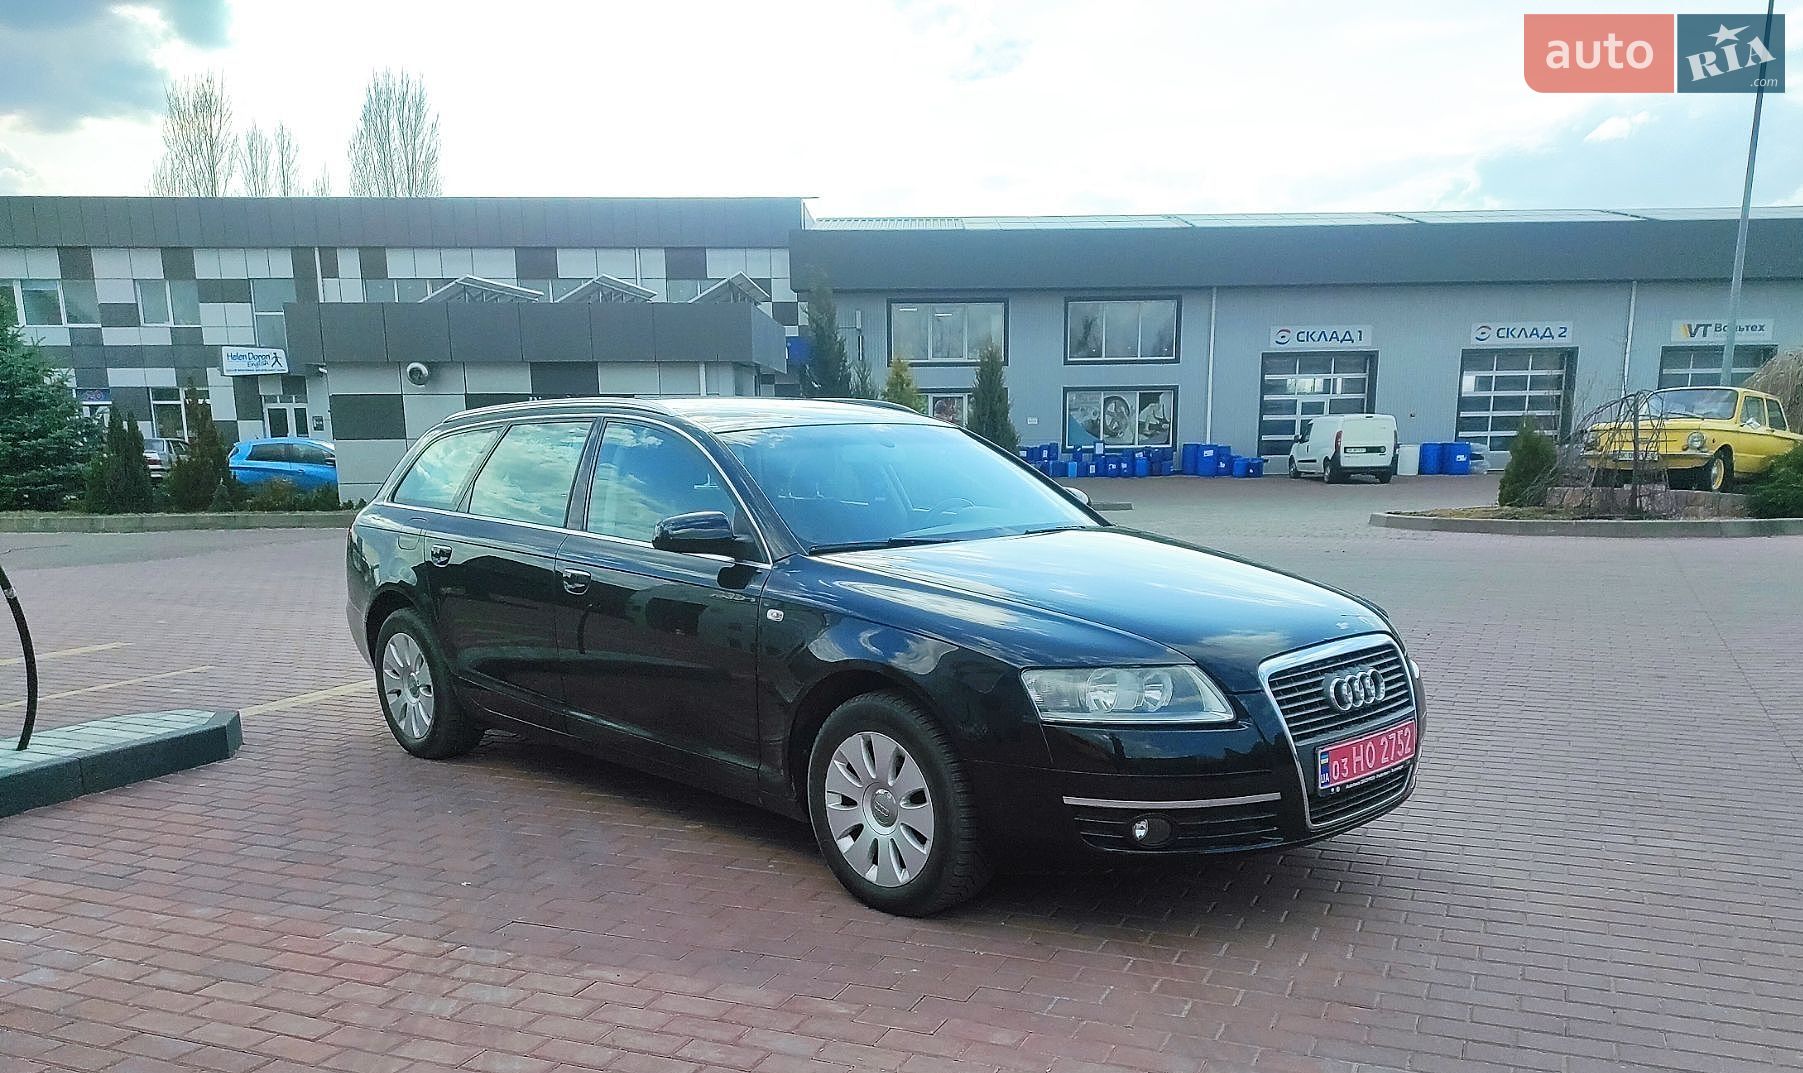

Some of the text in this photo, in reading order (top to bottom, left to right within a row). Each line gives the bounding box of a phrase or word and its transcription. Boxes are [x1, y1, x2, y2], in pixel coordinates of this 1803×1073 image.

[1296, 329, 1363, 343] СКЛАД 1
[1496, 326, 1568, 340] СКЛАД 2
[1687, 323, 1712, 338] VT
[227, 352, 270, 361] Helen Doron
[1332, 757, 1349, 781] 03
[1352, 741, 1376, 774] HO
[1380, 727, 1412, 764] 2752
[1321, 773, 1330, 783] UA
